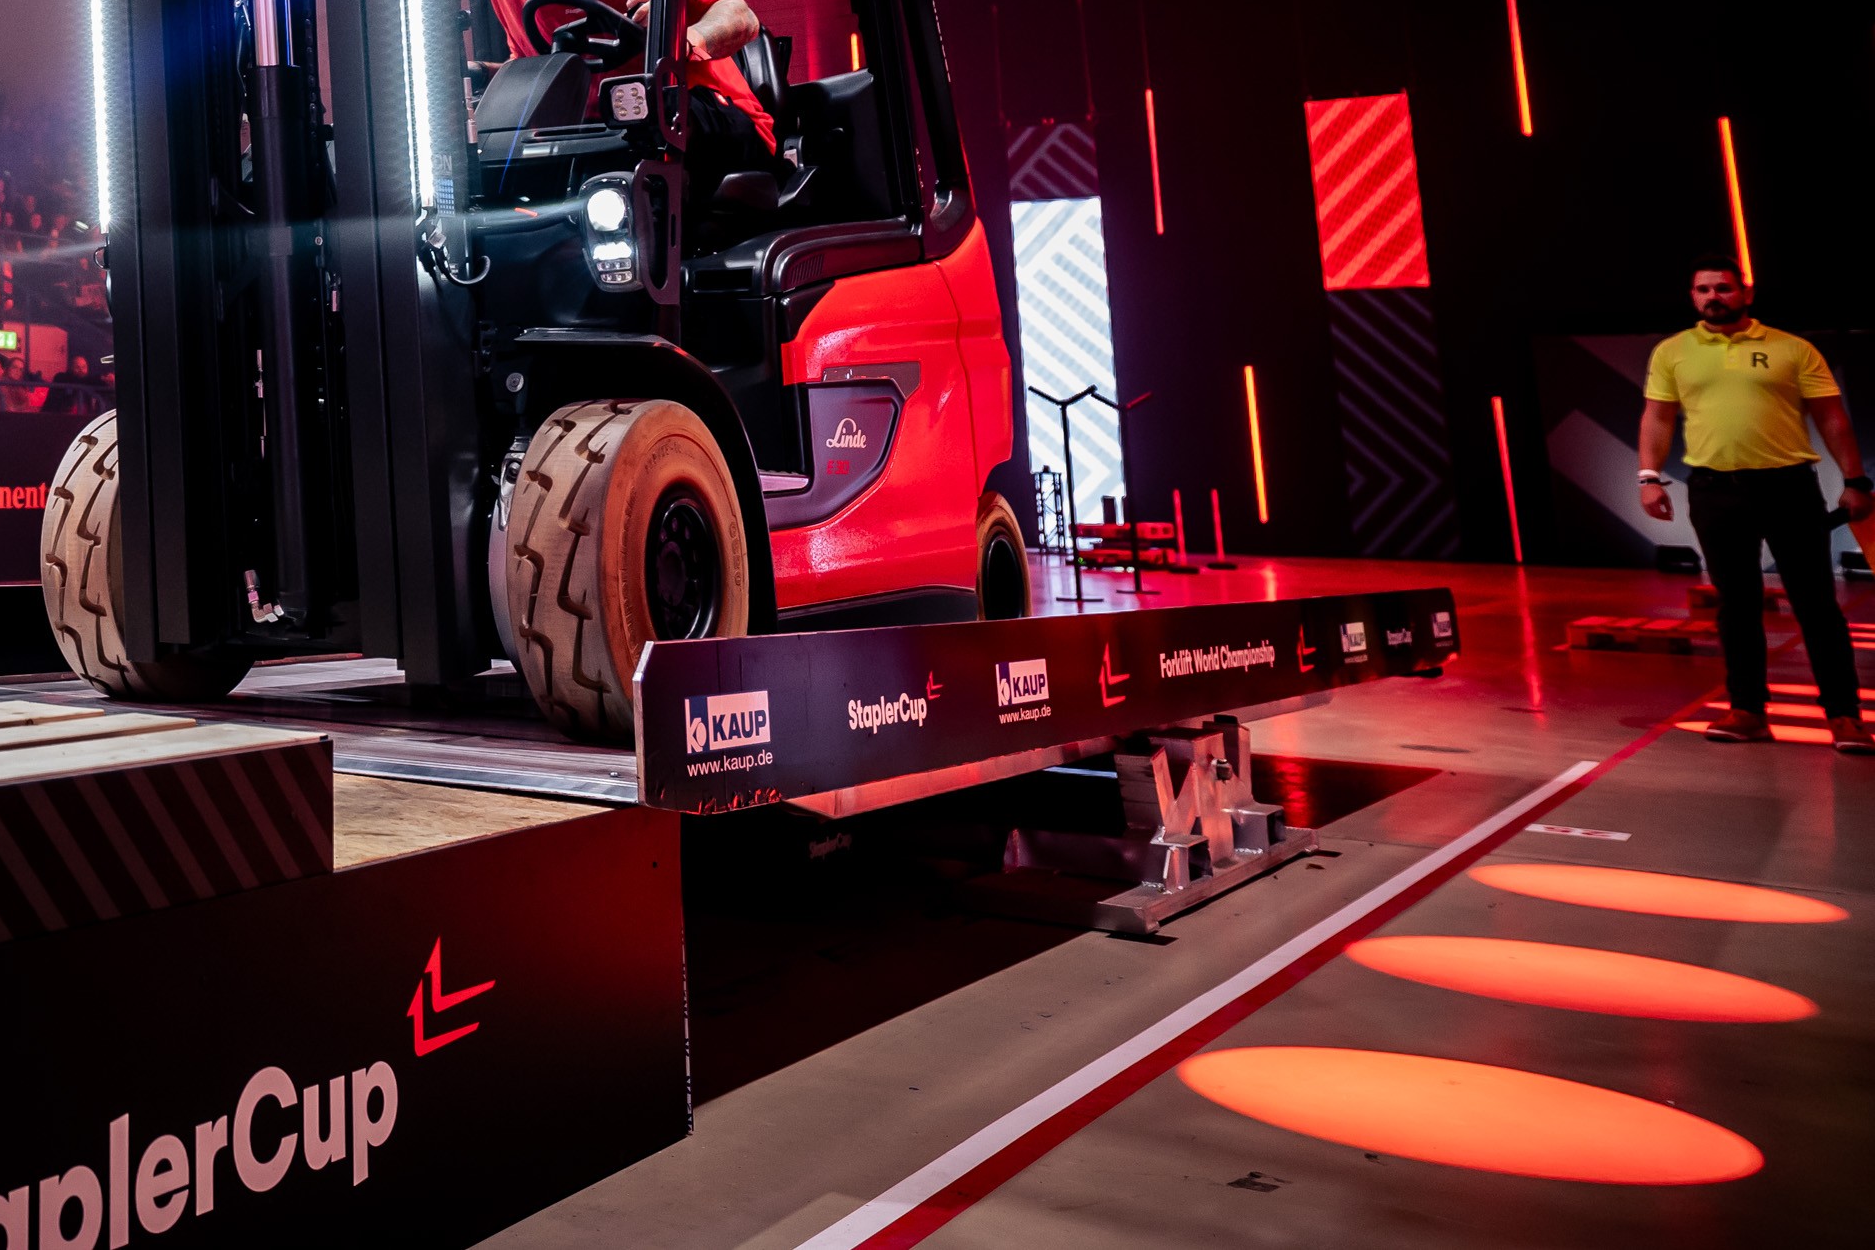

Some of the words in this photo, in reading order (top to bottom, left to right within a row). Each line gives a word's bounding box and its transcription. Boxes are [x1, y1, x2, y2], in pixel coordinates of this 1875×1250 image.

[1751, 352, 1769, 369] R
[826, 417, 866, 448] Linde
[1159, 649, 1194, 679] Forklift
[1192, 646, 1220, 673] World
[1220, 639, 1275, 672] Championship
[1012, 673, 1046, 698] KAUP
[712, 709, 767, 743] KAUP
[848, 692, 927, 734] StaplerCup
[998, 703, 1052, 724] www.kaup.de
[686, 749, 774, 777] www.kaup.de
